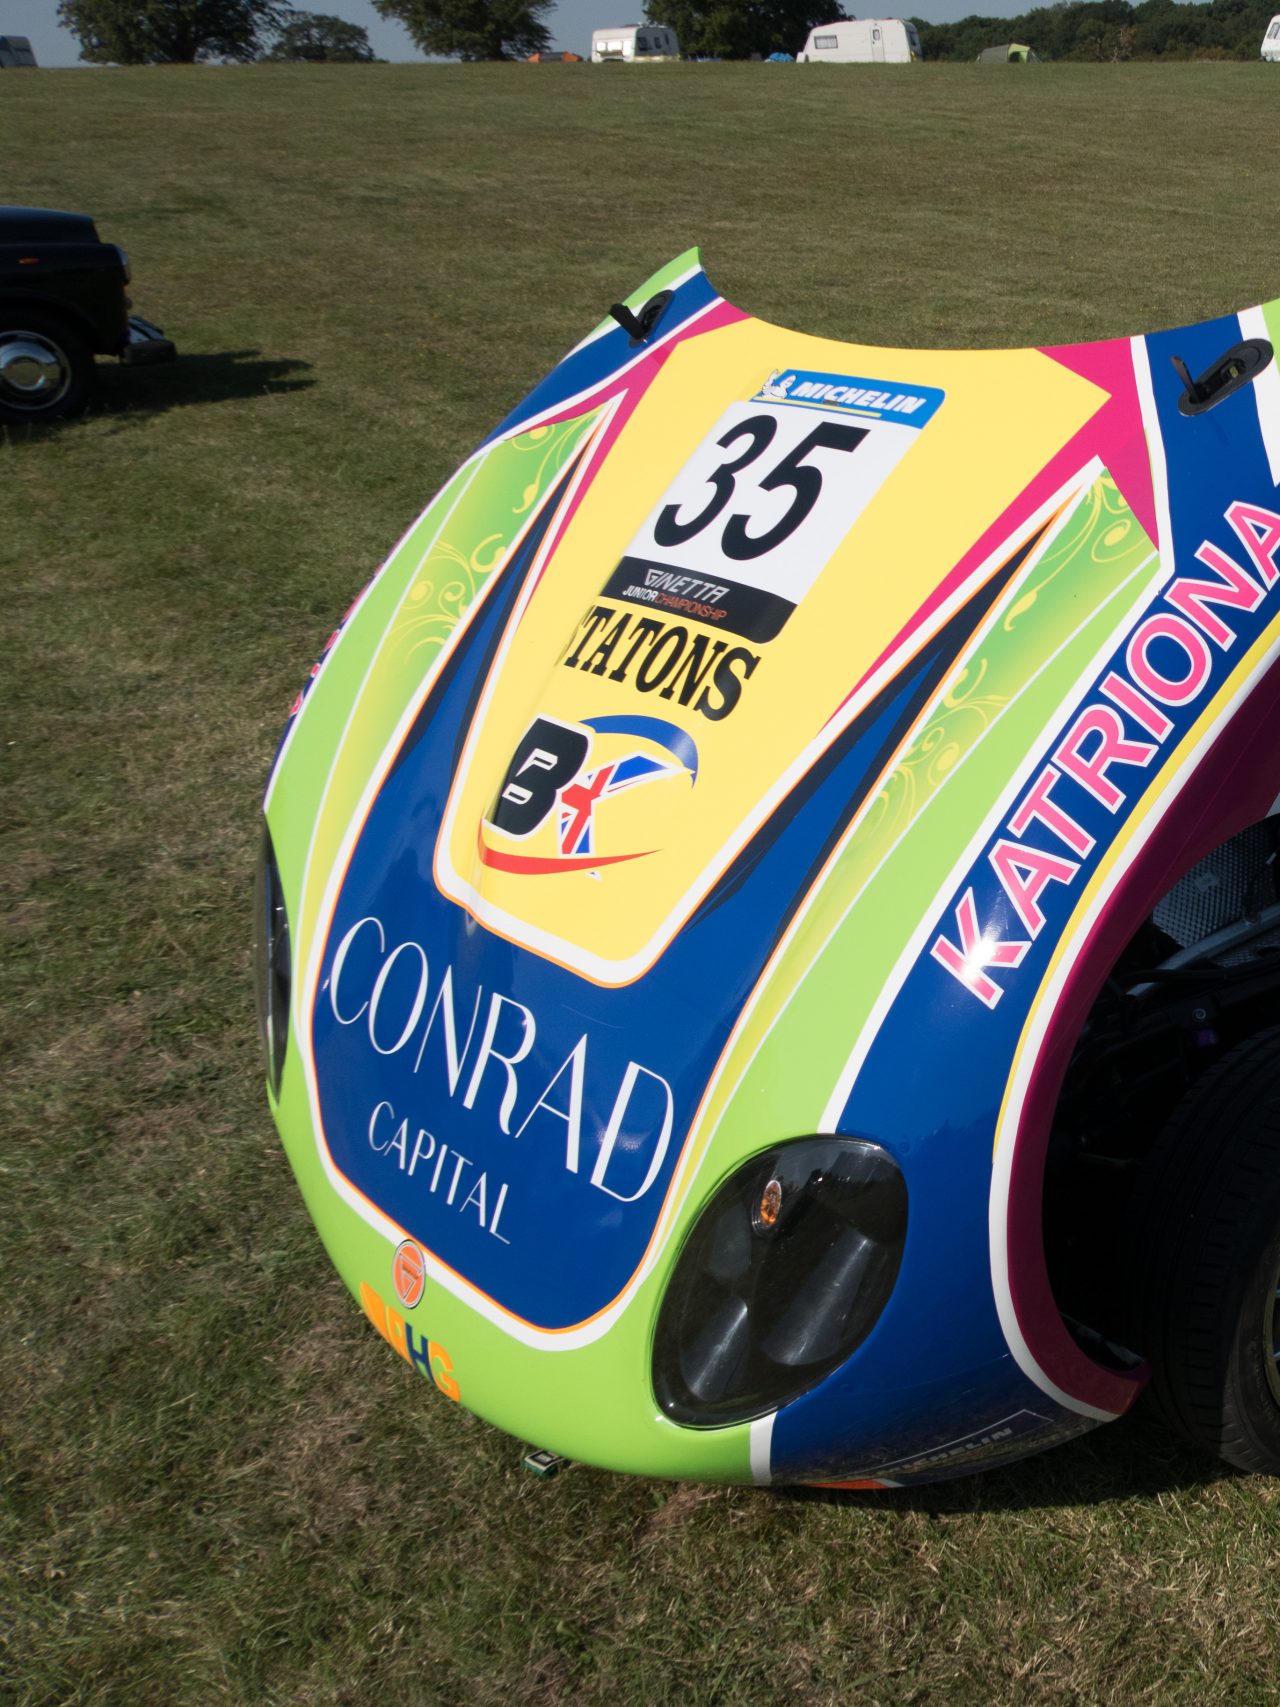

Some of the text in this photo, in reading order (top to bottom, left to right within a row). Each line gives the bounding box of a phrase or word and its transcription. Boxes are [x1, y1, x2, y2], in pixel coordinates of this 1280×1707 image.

[791, 381, 927, 415] MICHELIN
[653, 413, 871, 561] 35
[645, 567, 731, 604] GINETTA
[563, 603, 762, 721] TATONS
[330, 916, 674, 1202] CONRAD
[368, 1101, 511, 1245] CAPITAL
